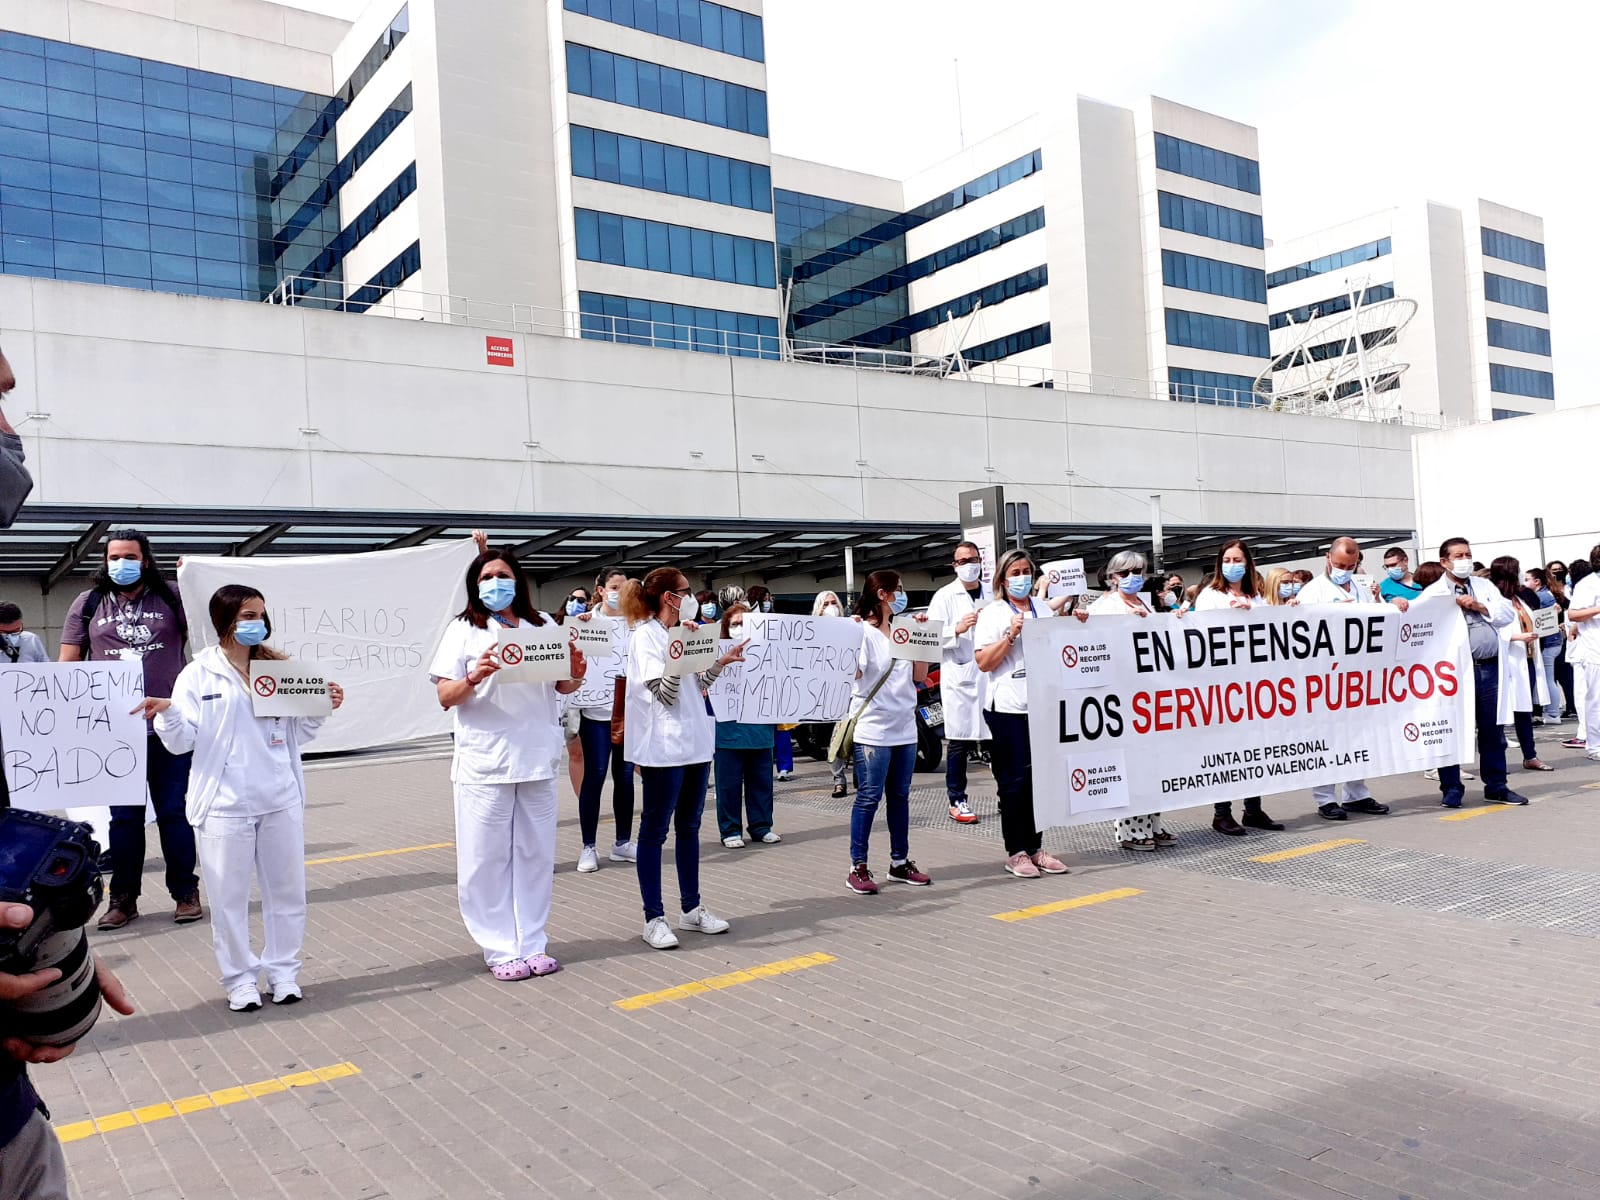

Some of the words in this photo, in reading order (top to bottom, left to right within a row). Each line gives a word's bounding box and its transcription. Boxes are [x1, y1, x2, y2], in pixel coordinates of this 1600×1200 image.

[143, 612, 164, 620] ME
[750, 618, 815, 641] MENOS
[684, 647, 714, 656] RECORTES
[909, 639, 940, 647] RECORTES
[1133, 630, 1175, 673] EN
[1184, 619, 1335, 669] DEFENSA
[1345, 616, 1385, 655] DE
[524, 653, 565, 662] RECORTES
[746, 645, 861, 676] SANITARIOS
[1080, 654, 1111, 663] RECORTES
[1081, 666, 1100, 674] COVID
[1, 668, 143, 702] PANDEMIA
[740, 675, 800, 721] MENOS
[803, 678, 852, 719] SALUD
[1059, 694, 1124, 743] LOS
[1132, 677, 1297, 734] SERVICIOS
[1306, 661, 1458, 713] PÚBLICOS
[20, 708, 55, 736] NO
[76, 705, 111, 733] HA
[1422, 728, 1453, 737] RECORTES
[1201, 752, 1241, 769] JUNTA
[1244, 750, 1262, 763] DE
[1265, 739, 1329, 760] PERSONAL
[1088, 775, 1122, 785] RECORTES
[1162, 766, 1265, 793] DEPARTAMENTO
[1267, 756, 1327, 777] VALENCIA
[1336, 753, 1351, 767] LA
[1355, 750, 1370, 763] FE
[1088, 788, 1108, 796] COVID
